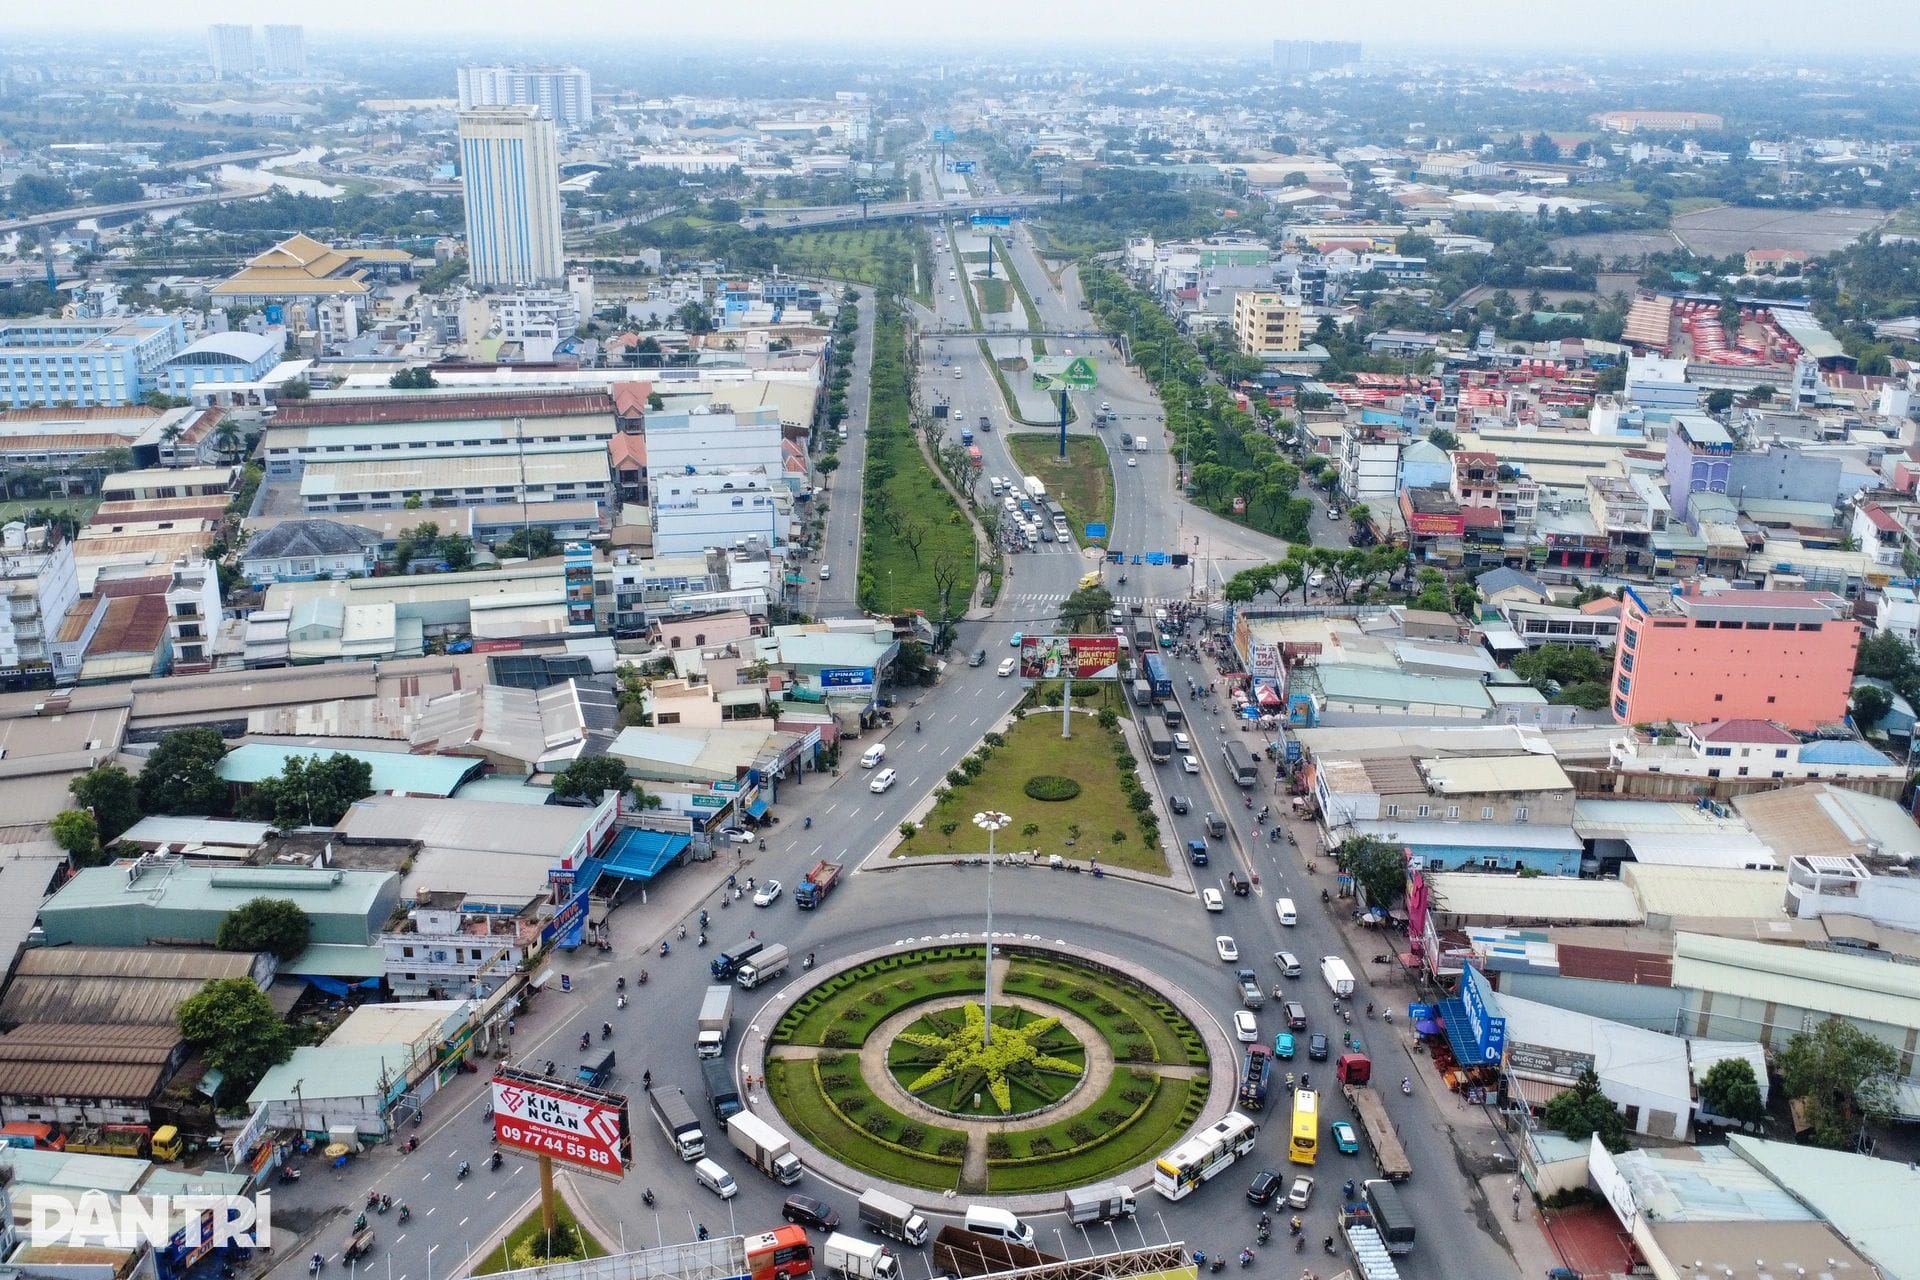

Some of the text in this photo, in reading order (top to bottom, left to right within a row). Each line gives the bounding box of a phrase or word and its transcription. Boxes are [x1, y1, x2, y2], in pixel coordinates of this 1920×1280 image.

[559, 901, 579, 926] VNVC
[1490, 1018, 1503, 1026] BÁN
[1485, 1046, 1501, 1059] 0%
[527, 1096, 560, 1114] KIM
[528, 1107, 579, 1130] NGAN
[528, 1125, 541, 1133] LIÊN
[548, 1129, 566, 1139] QUẢNG
[566, 1133, 580, 1142] CÁO
[501, 1125, 609, 1165] 09 77 44 55 88
